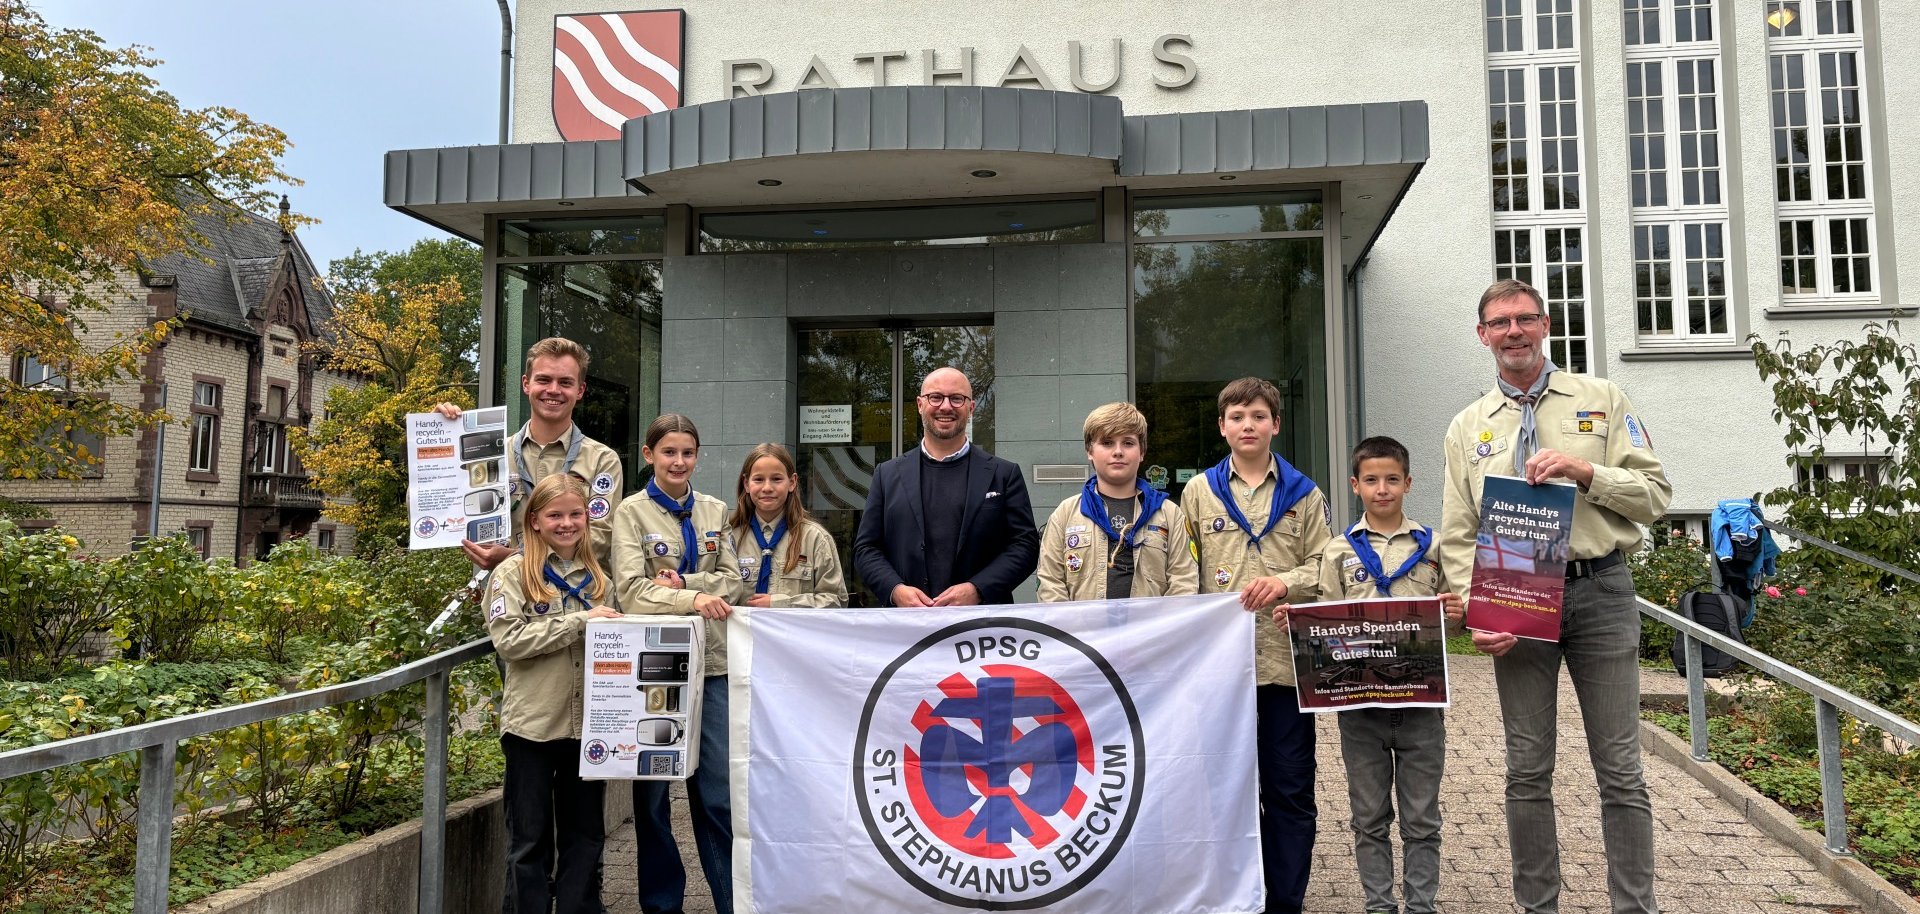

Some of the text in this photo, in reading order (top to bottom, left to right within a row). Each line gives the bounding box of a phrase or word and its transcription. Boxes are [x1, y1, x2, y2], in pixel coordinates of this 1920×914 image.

[721, 33, 1198, 99] RATHAUS
[415, 420, 443, 429] Handys
[415, 428, 445, 437] recyceln
[416, 437, 438, 445] Gutes
[1492, 500, 1559, 519] Alte Handys
[1488, 513, 1560, 530] recyceln und
[1495, 525, 1550, 541] Gutes tun.
[1494, 591, 1537, 603] Sammelboxen
[1498, 585, 1511, 593] und
[1510, 586, 1540, 597] Standorte
[1490, 598, 1557, 613] www.dpsg-beckum.de
[1309, 621, 1421, 637] Handys Spenden
[594, 631, 623, 642] Handys
[593, 640, 624, 651] recyceln
[954, 635, 1042, 664] DPSG
[593, 651, 630, 659] Gutes tun
[1331, 646, 1398, 661] Gutes tun!
[1344, 684, 1374, 693] Standorte
[1384, 683, 1429, 691] Sammelboxen
[1348, 691, 1414, 699] www.dpsg-beckum.de
[872, 743, 1128, 895] ST. STEPHANUS BECKUM
